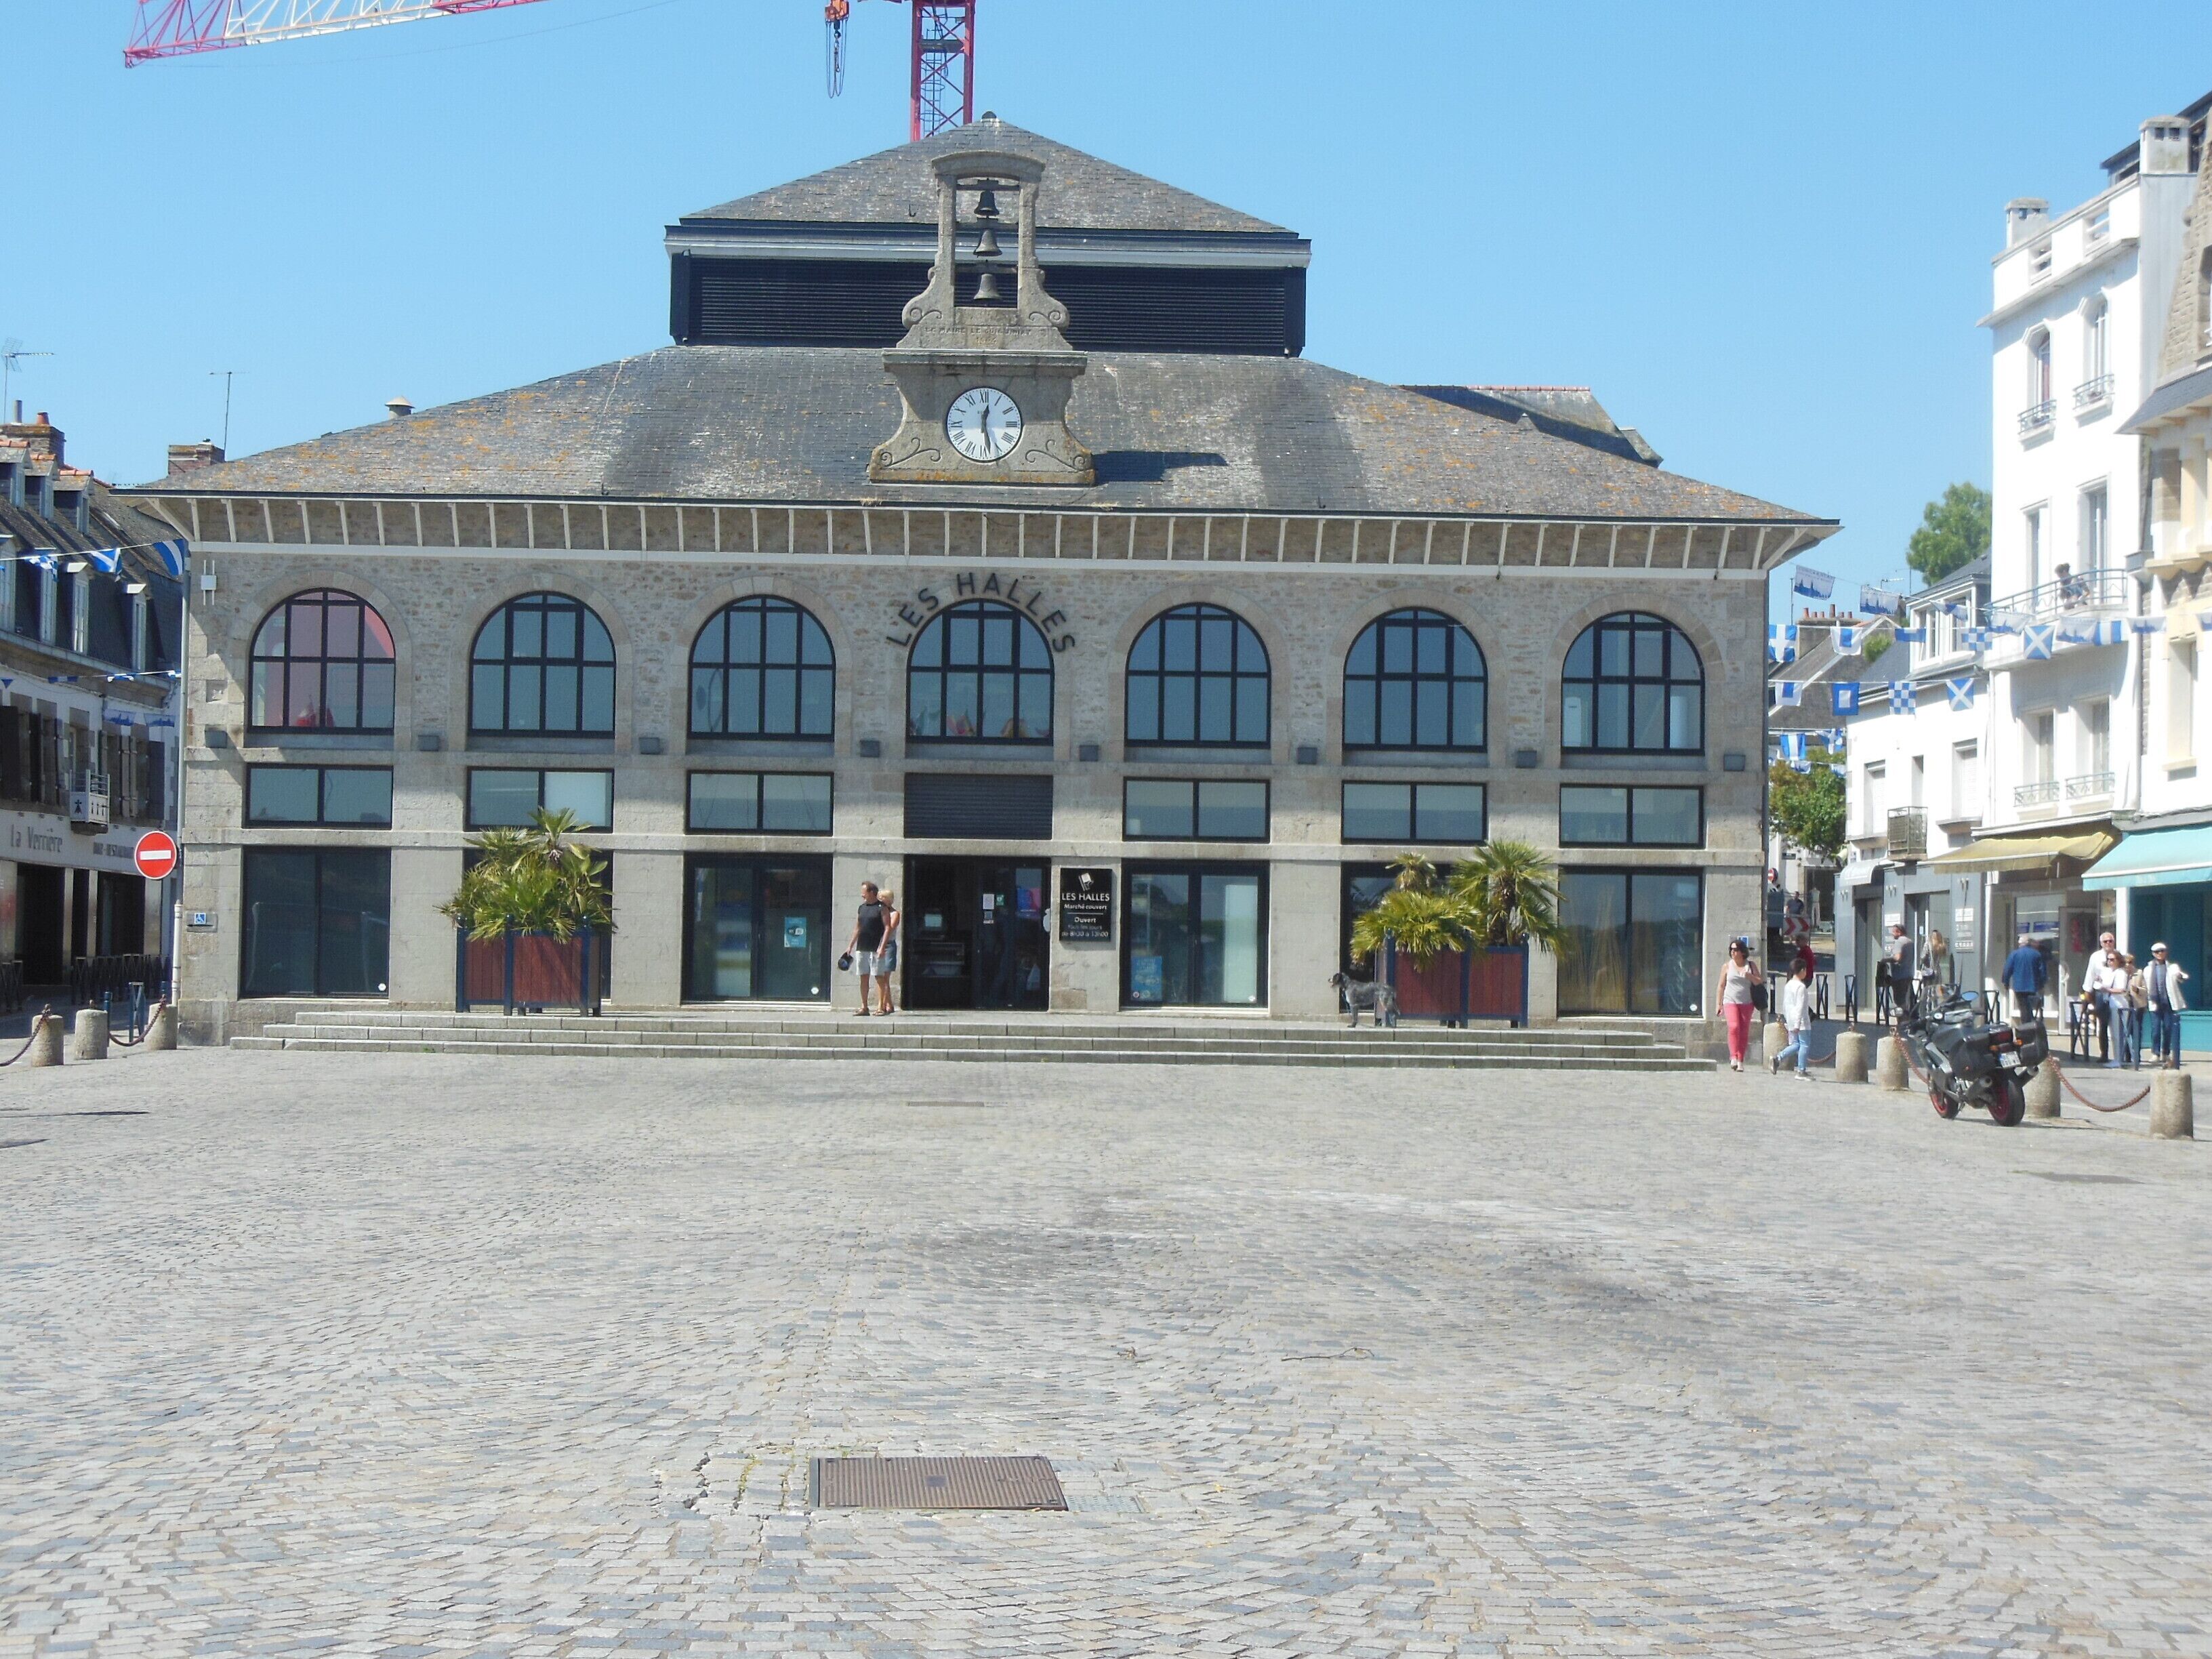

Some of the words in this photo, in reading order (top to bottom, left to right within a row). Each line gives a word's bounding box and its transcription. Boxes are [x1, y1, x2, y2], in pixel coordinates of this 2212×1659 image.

[980, 391, 989, 403] XII
[886, 588, 939, 647] LES
[956, 572, 1075, 653] HALLES
[1061, 893, 1076, 901] LES
[1078, 893, 1110, 901] HALLES
